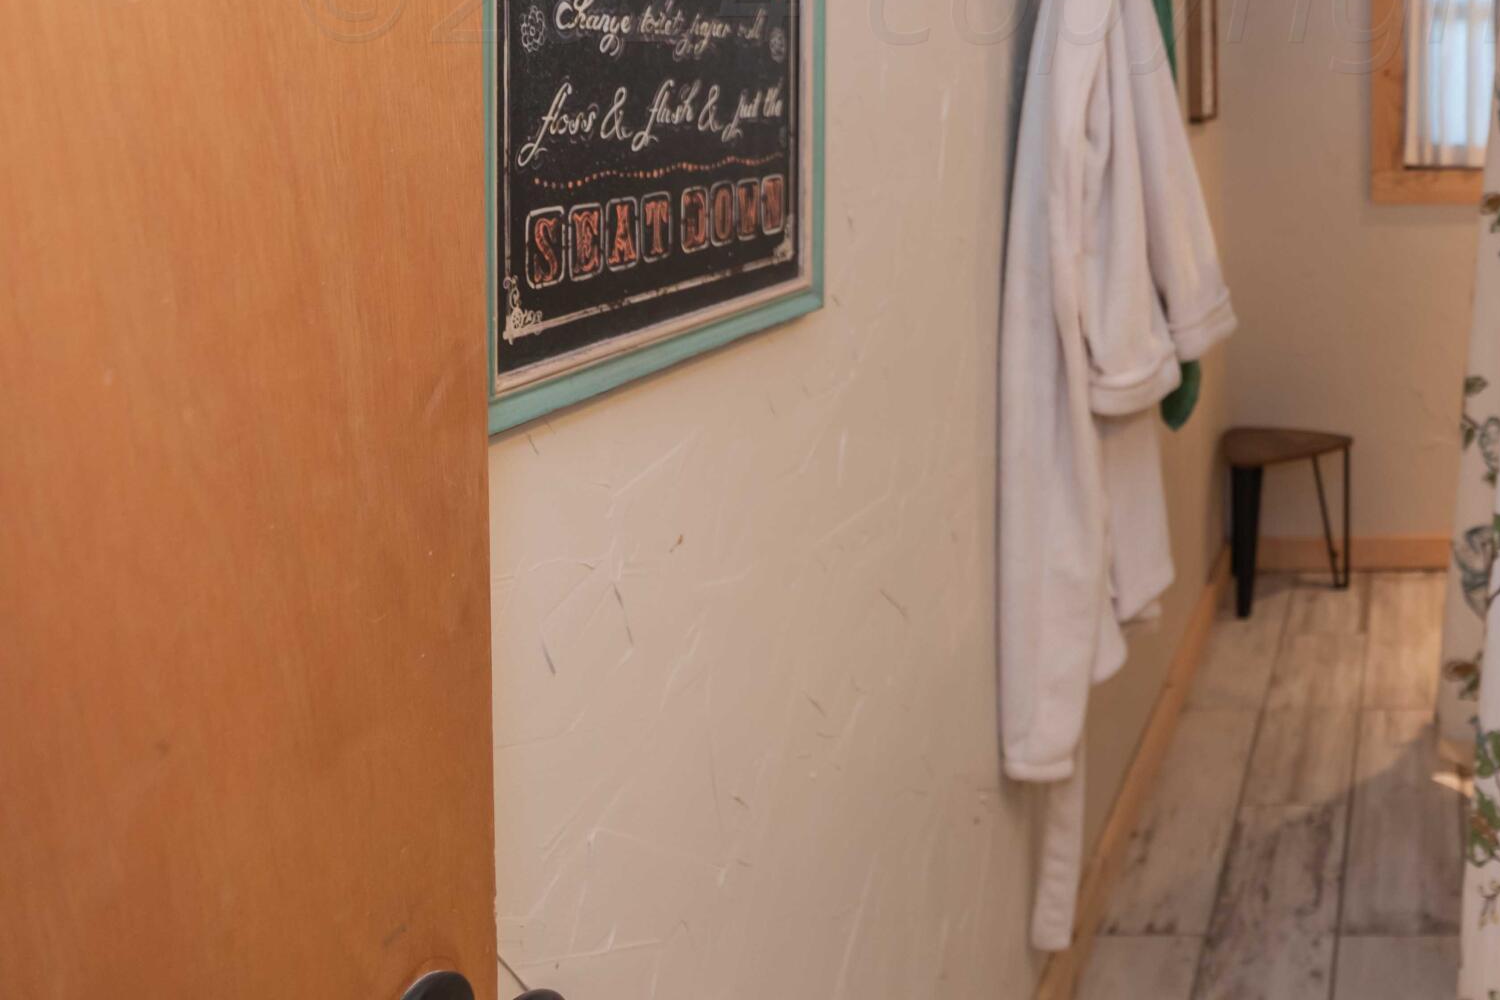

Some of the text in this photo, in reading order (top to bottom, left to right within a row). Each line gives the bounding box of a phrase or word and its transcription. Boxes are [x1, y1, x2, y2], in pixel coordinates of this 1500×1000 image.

[518, 81, 598, 167] floss
[600, 86, 633, 140] &
[631, 79, 700, 152] flush
[698, 85, 723, 132] &
[531, 177, 784, 284] SEAT DOWN
